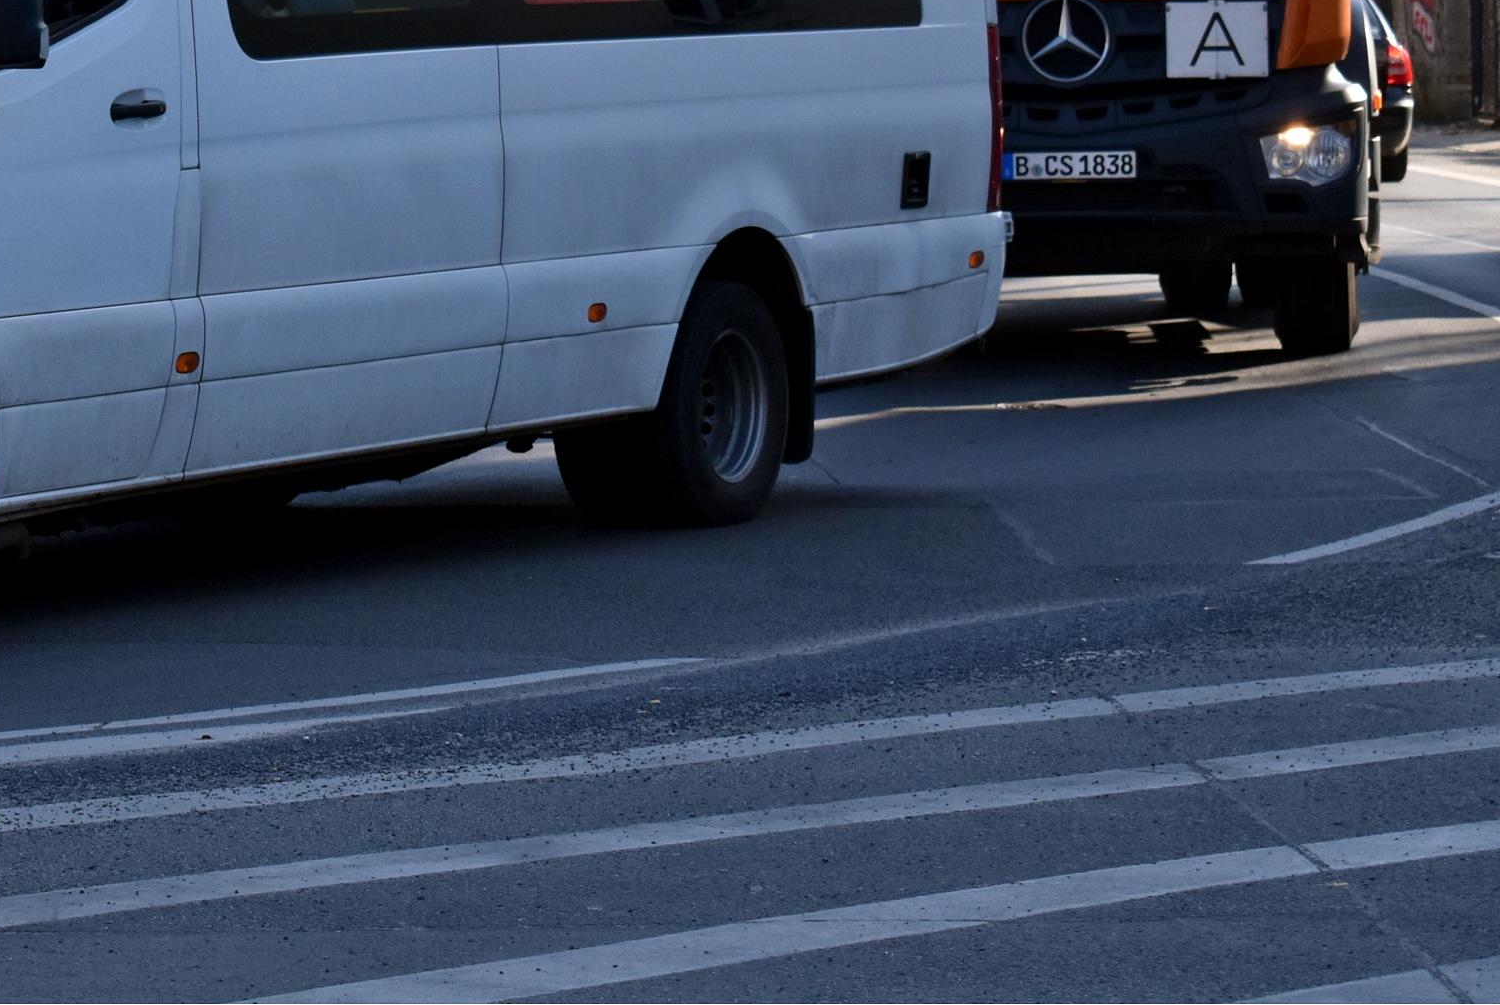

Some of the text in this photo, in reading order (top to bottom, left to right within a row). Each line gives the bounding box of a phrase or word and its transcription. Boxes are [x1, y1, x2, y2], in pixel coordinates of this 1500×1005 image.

[1189, 11, 1246, 67] A
[1015, 156, 1030, 177] B
[1044, 155, 1074, 176] CS
[1078, 154, 1133, 176] 1838
